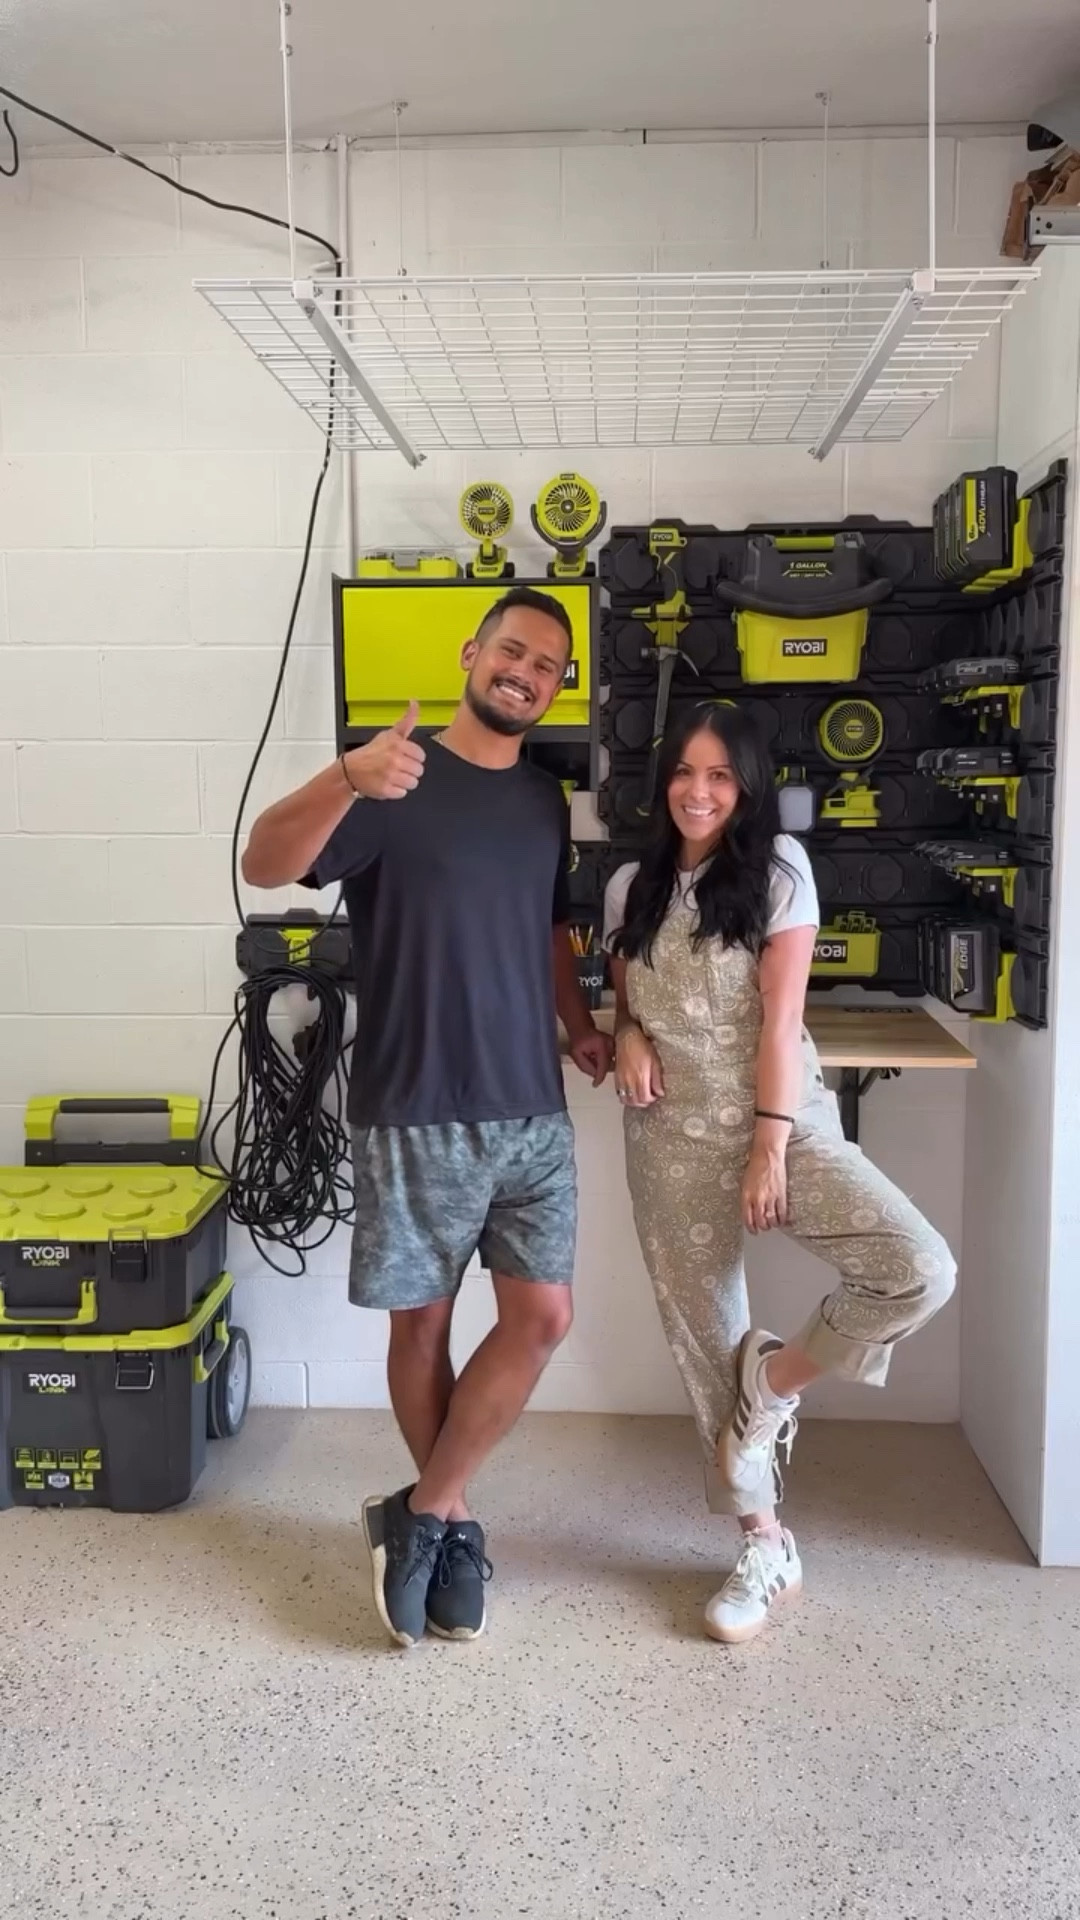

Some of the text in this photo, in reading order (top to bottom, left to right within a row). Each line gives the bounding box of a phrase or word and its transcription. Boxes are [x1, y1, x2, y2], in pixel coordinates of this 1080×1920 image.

[784, 641, 824, 653] RYOBI
[813, 944, 846, 957] YOBI
[959, 938, 968, 969] EDGE
[21, 1246, 70, 1260] RYOBI
[28, 1373, 75, 1387] RYOBI
